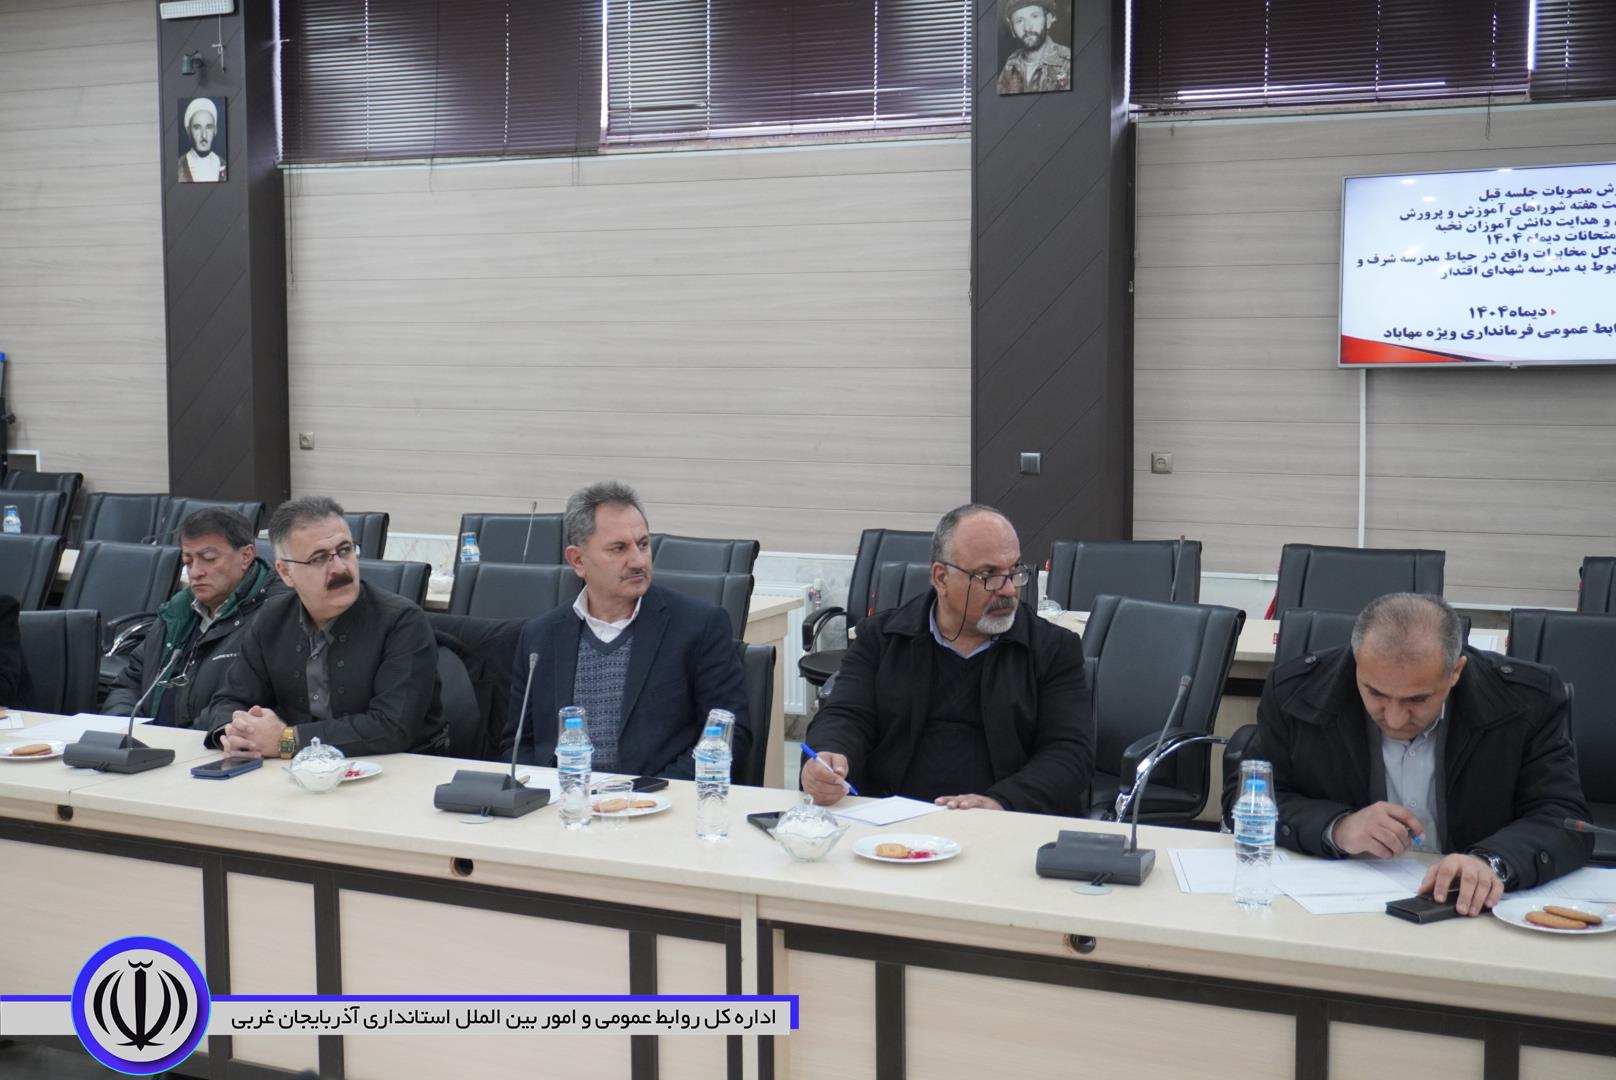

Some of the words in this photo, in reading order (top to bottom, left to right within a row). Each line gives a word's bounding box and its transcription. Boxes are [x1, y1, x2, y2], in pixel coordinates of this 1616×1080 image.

[1479, 188, 1501, 202] قبل
[1504, 187, 1538, 199] جلسه
[1542, 186, 1592, 198] مصوبات
[1457, 202, 1505, 219] آموزش
[1509, 201, 1566, 216] شوراهای
[1570, 199, 1597, 210] هفته
[1399, 208, 1443, 221] پرورش
[1447, 210, 1454, 219] و
[1435, 220, 1462, 234] نخبه
[1466, 217, 1512, 233] آموزان
[1516, 217, 1552, 231] دانش
[1555, 216, 1599, 228] هدایت
[1603, 218, 1610, 227] و
[1487, 232, 1522, 245] ۱۴۰۴
[1564, 231, 1616, 242] متحانات
[1366, 252, 1396, 267] شرف
[1400, 254, 1440, 265] مدرسه
[1444, 251, 1477, 263] حیاط
[1481, 251, 1496, 263] در
[1500, 248, 1529, 262] واقع
[1533, 246, 1587, 260] مخابات
[1357, 258, 1364, 267] و
[1574, 263, 1587, 275] به
[1440, 264, 1478, 280] اقتدار
[1481, 264, 1524, 278] شهدای
[1528, 264, 1570, 276] مدرسه
[1383, 326, 1422, 341] مهاباد
[1426, 327, 1457, 341] ویژه
[1461, 323, 1534, 341] فرمانداری
[1537, 325, 1588, 338] عمومی
